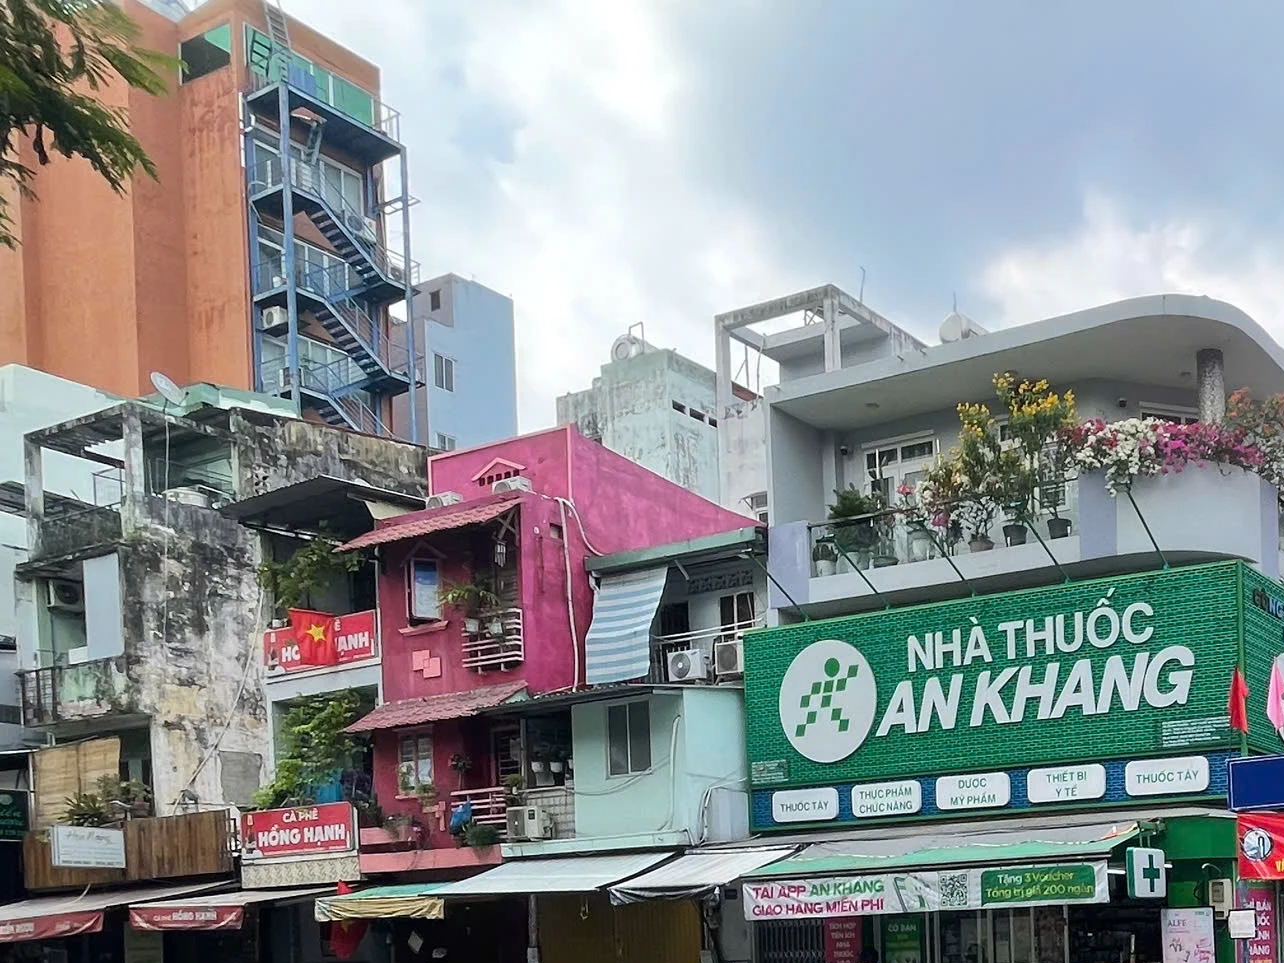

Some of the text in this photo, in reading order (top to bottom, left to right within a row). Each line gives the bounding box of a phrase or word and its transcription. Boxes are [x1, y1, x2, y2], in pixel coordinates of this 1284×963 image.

[907, 588, 1154, 672] NHÀ THUỐC
[876, 645, 1194, 737] AN KHANG
[1055, 786, 1077, 797] Y TẾ
[258, 823, 346, 847] HỒNG HẠNH
[997, 870, 1074, 887] Tặng 3 Voucher
[777, 880, 885, 899] APP AN KHANG
[1043, 884, 1066, 895] 200
[752, 904, 783, 916] GIAO
[861, 897, 885, 911] PHÍ
